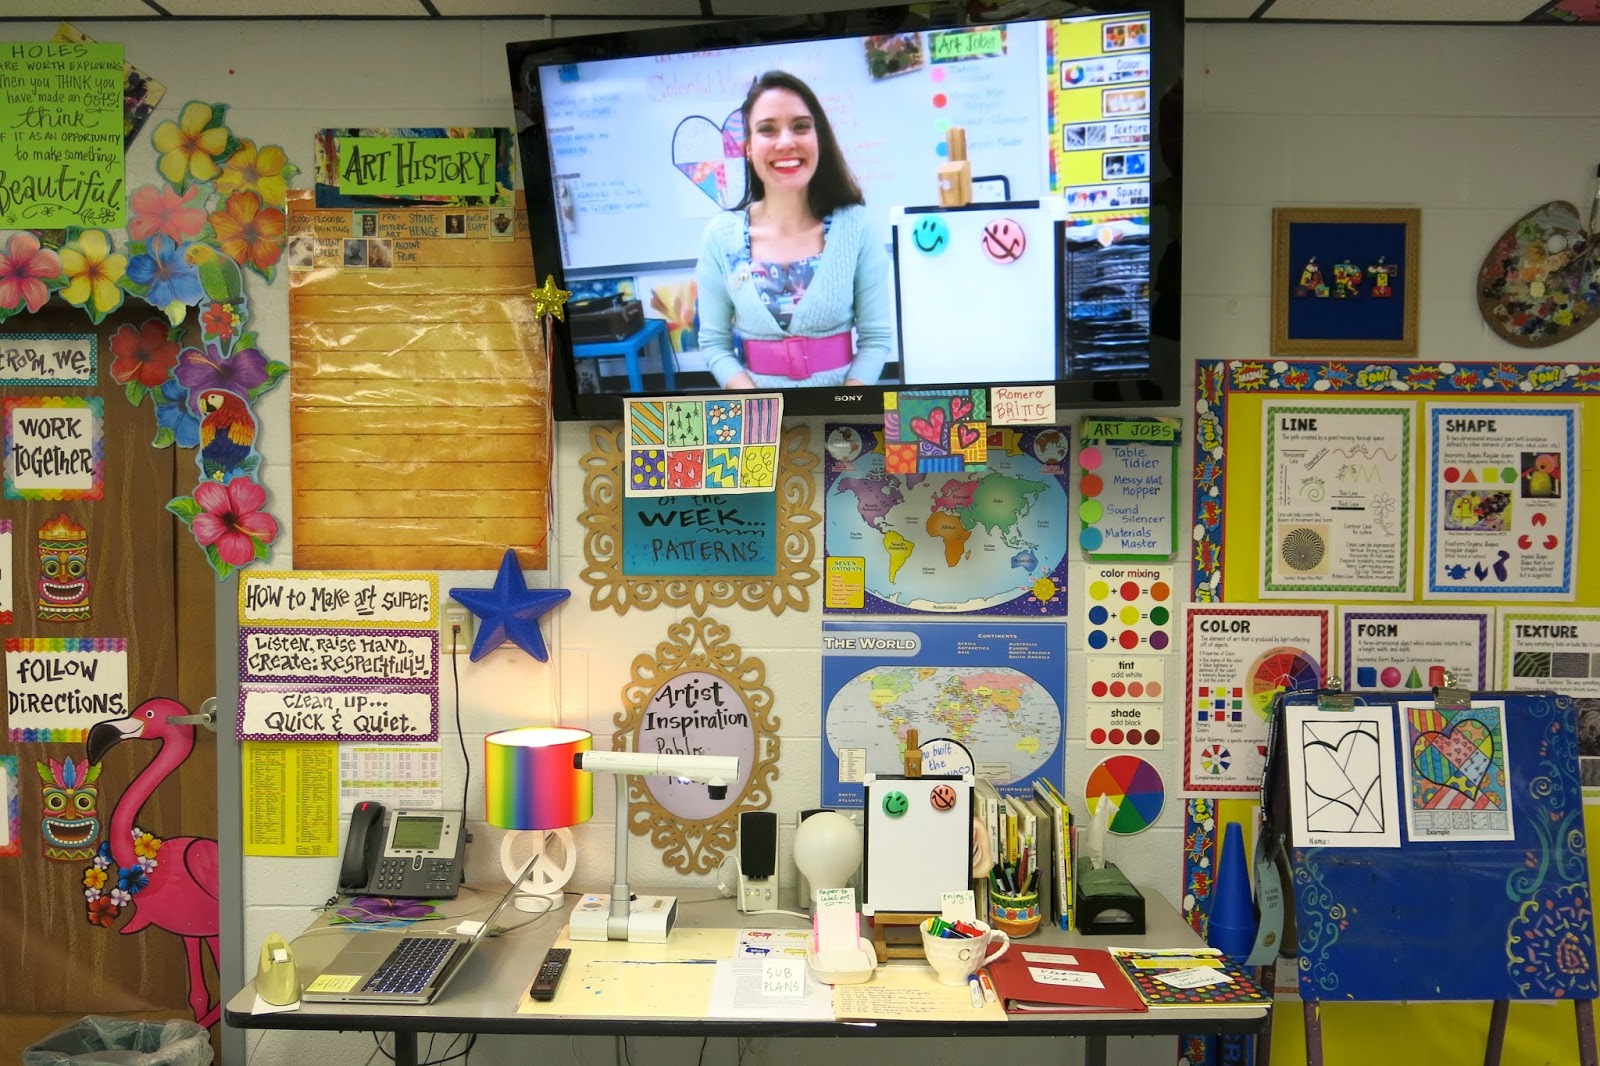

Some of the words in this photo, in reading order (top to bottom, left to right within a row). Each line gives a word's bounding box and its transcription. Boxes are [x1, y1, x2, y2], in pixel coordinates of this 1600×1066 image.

[12, 44, 88, 58] HOLES
[27, 61, 65, 71] WORTH
[1116, 58, 1141, 70] Color
[30, 77, 50, 95] you
[56, 75, 92, 90] THINK
[95, 78, 115, 94] you
[6, 90, 32, 104] have
[38, 91, 65, 103] made
[68, 95, 80, 103] an
[10, 106, 99, 129] think
[1114, 123, 1148, 134] Texture
[14, 132, 25, 141] IT
[29, 132, 42, 141] AS
[44, 132, 57, 141] AN
[61, 132, 121, 146] OPPORTUNITY
[15, 144, 28, 161] to
[33, 147, 62, 163] make
[342, 145, 391, 186] ART
[1117, 186, 1143, 198] Space
[1531, 369, 1560, 387] POW!
[997, 388, 1045, 400] Romero
[1094, 423, 1122, 437] ART
[1131, 424, 1171, 437] JOBS
[1281, 418, 1317, 431] LINE
[1446, 419, 1497, 432] SHAPE
[1112, 446, 1147, 458] Table
[1121, 458, 1159, 469] Tidier
[1113, 475, 1143, 486] Messy
[1146, 475, 1164, 486] Mat
[1122, 487, 1161, 499] Mopper
[1107, 504, 1139, 515] Sound
[638, 508, 766, 527] WEEK...
[1122, 514, 1165, 524] Silencer
[1105, 526, 1151, 538] Materials
[1121, 538, 1157, 549] Master
[652, 538, 759, 563] PATTERNS
[1100, 568, 1125, 578] color
[1127, 568, 1160, 580] mixing
[287, 588, 306, 610] to
[932, 604, 957, 612] Antarctica
[1200, 619, 1250, 634] COLOR
[1358, 624, 1398, 637] FORM
[1516, 625, 1578, 638] TEXTURE
[823, 637, 856, 649] THE
[861, 636, 916, 650] WORLD
[1118, 660, 1135, 670] tint
[1125, 671, 1143, 679] white
[655, 679, 725, 708] Artist
[1110, 708, 1141, 718] shade
[644, 708, 748, 737] Inspiration
[1426, 828, 1450, 836] Example
[1309, 837, 1331, 846] Name:
[766, 967, 793, 979] SUB
[764, 980, 800, 993] PLANS
